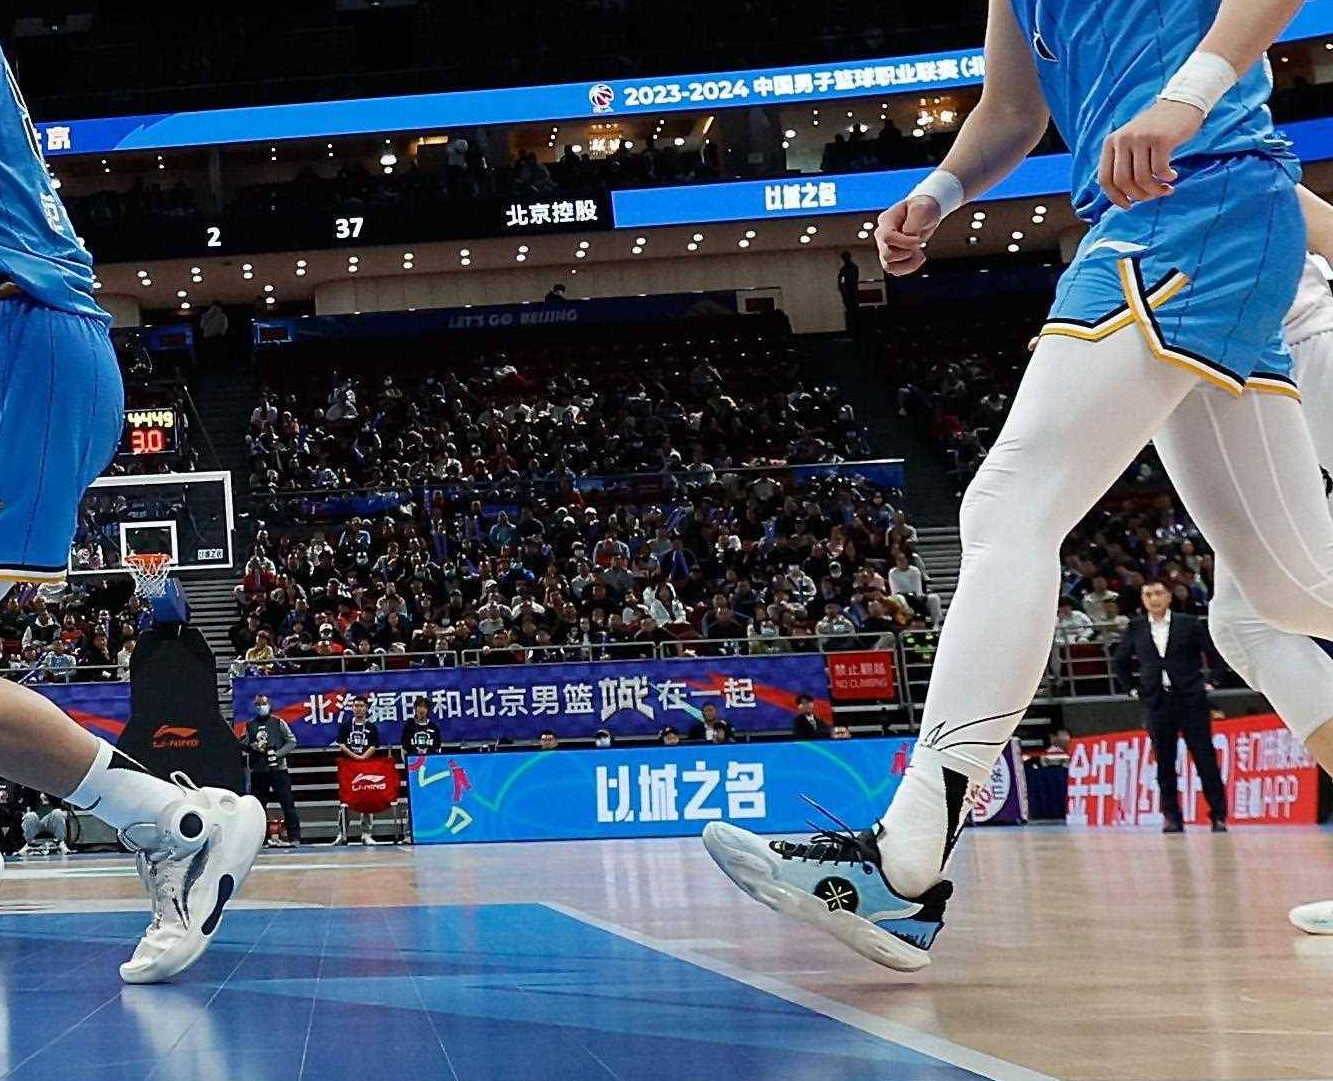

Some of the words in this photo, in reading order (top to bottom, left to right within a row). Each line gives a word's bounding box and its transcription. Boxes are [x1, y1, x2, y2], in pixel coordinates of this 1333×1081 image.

[623, 79, 749, 107] 2023-2024
[335, 217, 364, 238] 37
[505, 200, 598, 228] 北京控股
[206, 226, 222, 247] 2
[596, 761, 766, 823] 以城之名
